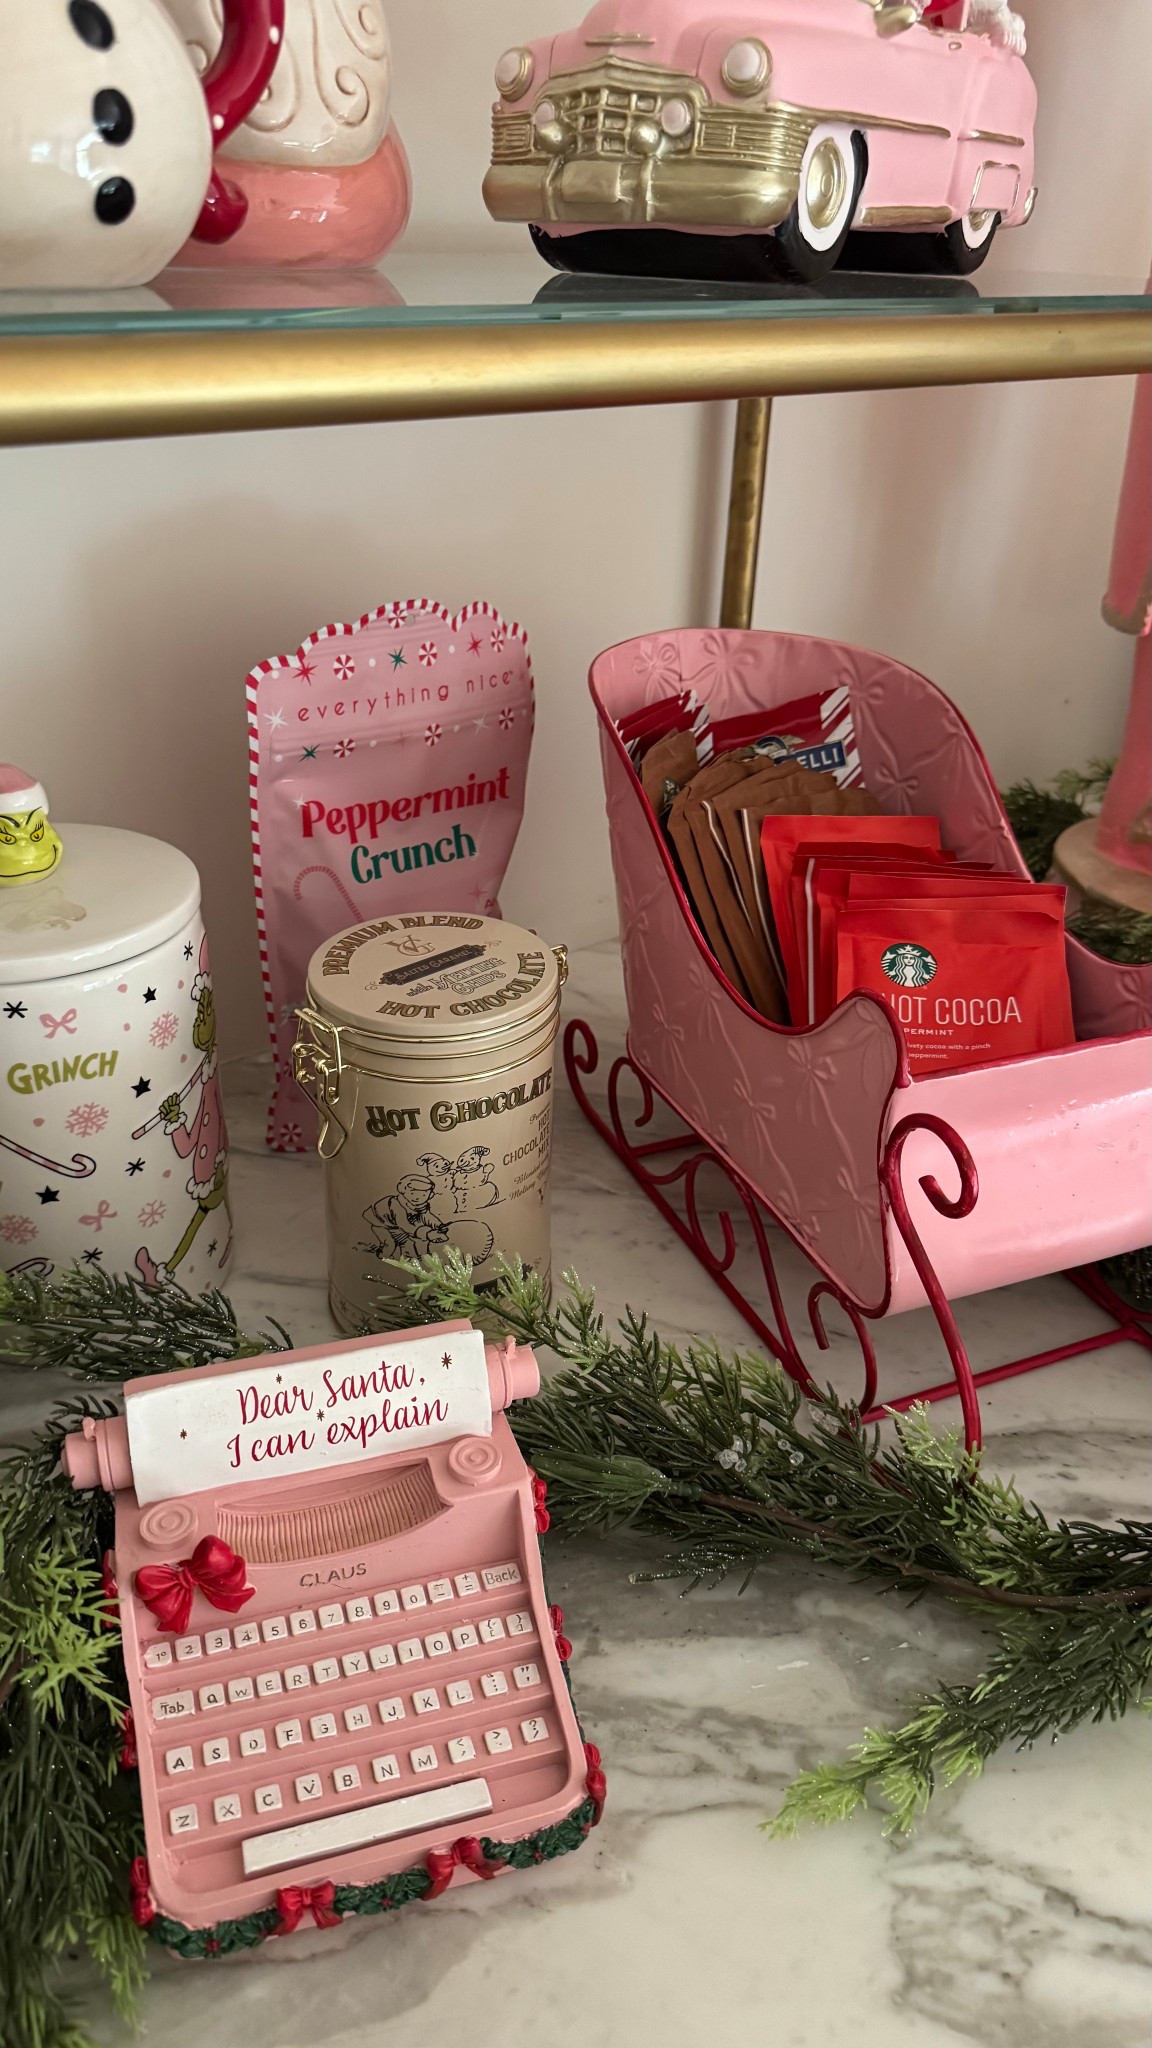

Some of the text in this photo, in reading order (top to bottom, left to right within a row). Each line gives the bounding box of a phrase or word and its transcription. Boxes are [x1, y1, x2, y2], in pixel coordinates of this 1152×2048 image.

[298, 671, 511, 722] everything nice
[796, 747, 840, 769] ELLI
[302, 766, 510, 844] Peppermint
[350, 824, 477, 884] Crunch
[322, 915, 484, 977] PREMIUM BLEND
[376, 951, 546, 1019] HOT CHOCOLATE
[935, 996, 1022, 1026] COCOA
[903, 1027, 954, 1036] PERMINT
[7, 1050, 119, 1095] GRINCH
[430, 1068, 552, 1133] CHOCOLATE
[502, 1122, 550, 1167] CHOCOLATE
[236, 1360, 426, 1425] Dear Santa,
[250, 1429, 315, 1464] can
[326, 1396, 449, 1449] explain
[299, 1562, 368, 1588] CLAUS
[185, 1644, 194, 1655] 2
[214, 1637, 224, 1648] 3
[271, 1625, 280, 1637] 5
[298, 1619, 308, 1630] 6
[354, 1606, 365, 1618] 8
[382, 1600, 391, 1611] 9
[484, 1567, 518, 1586] Back
[160, 1701, 185, 1715] Tab
[264, 1680, 274, 1691] E
[292, 1675, 303, 1686] R
[321, 1667, 332, 1678] T
[350, 1659, 361, 1671] Y
[460, 1633, 470, 1645] P
[172, 1757, 186, 1770] A
[211, 1747, 221, 1760] S
[285, 1729, 294, 1741] F
[320, 1723, 330, 1734] G
[352, 1713, 364, 1725] H
[387, 1705, 397, 1717] J
[422, 1697, 434, 1709] K
[455, 1689, 466, 1701] L
[178, 1815, 191, 1828] Z
[221, 1803, 236, 1818] X
[262, 1793, 275, 1806] C
[342, 1774, 353, 1788] B
[381, 1763, 394, 1778] N
[417, 1754, 433, 1767] M
